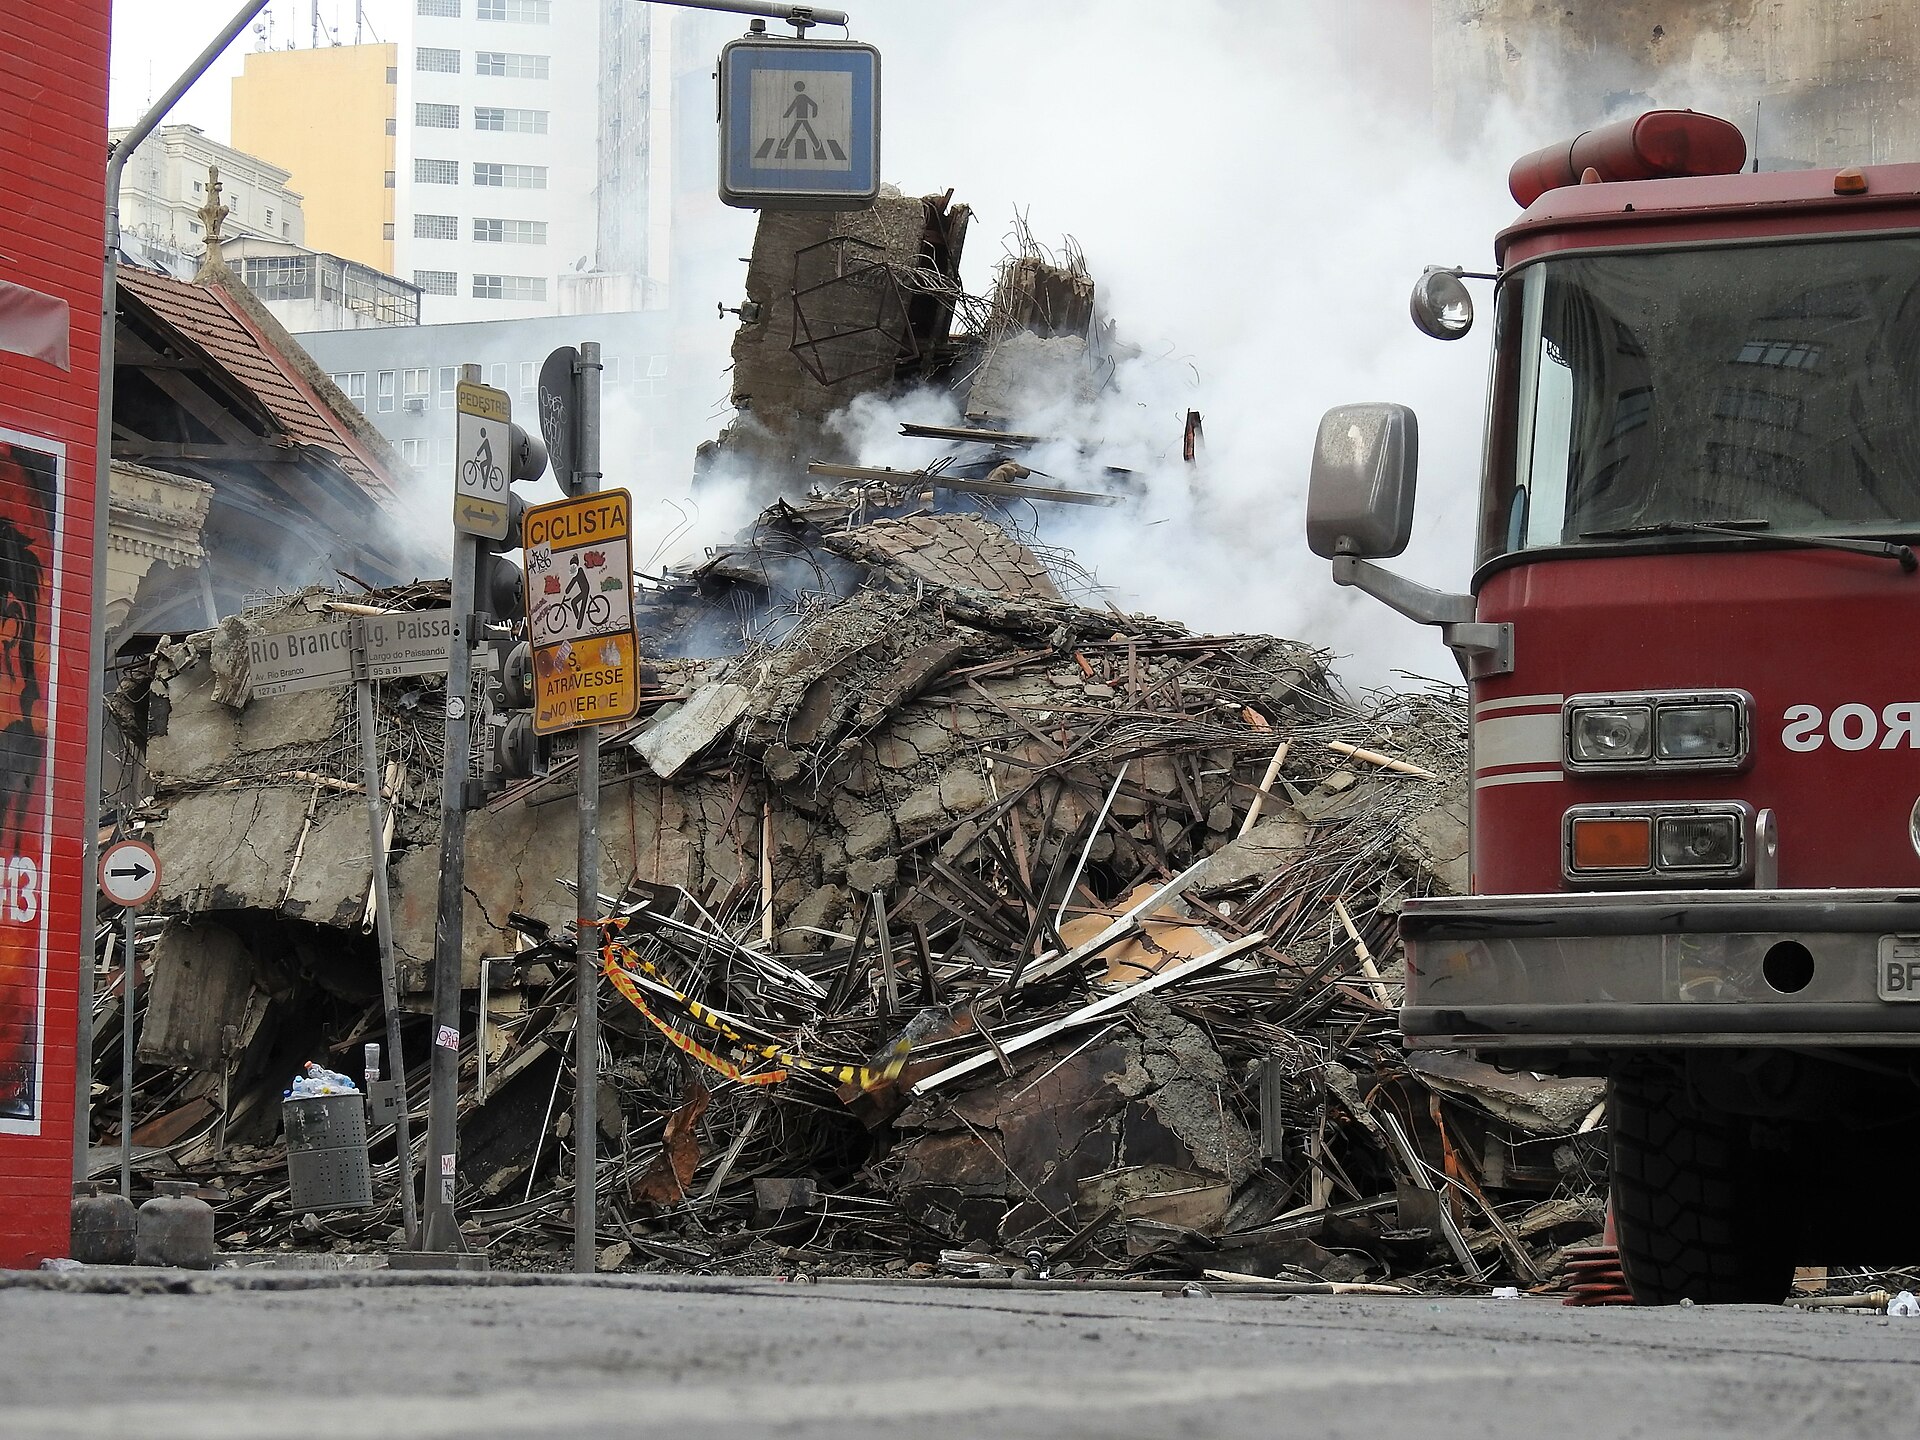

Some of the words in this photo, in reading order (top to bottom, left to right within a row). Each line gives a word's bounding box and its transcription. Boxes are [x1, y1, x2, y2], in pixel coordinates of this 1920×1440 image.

[460, 391, 507, 415] PEDESTRE
[530, 504, 625, 545] CICLISTA
[366, 624, 388, 647] Lg.
[397, 617, 450, 640] Paissa
[251, 639, 279, 664] Rio
[287, 629, 349, 657] Branco
[368, 652, 391, 661] Largo
[393, 651, 403, 659] do
[405, 647, 445, 658] Paissandú
[255, 673, 265, 681] Av.
[267, 671, 279, 679] Rio
[280, 667, 305, 677] Branco
[373, 668, 383, 676] 95
[392, 666, 402, 674] 81
[546, 668, 624, 697] ATRAVESSE
[258, 687, 270, 696] 127
[278, 684, 287, 693] 17
[550, 701, 567, 719] NO
[569, 692, 618, 713] VERE
